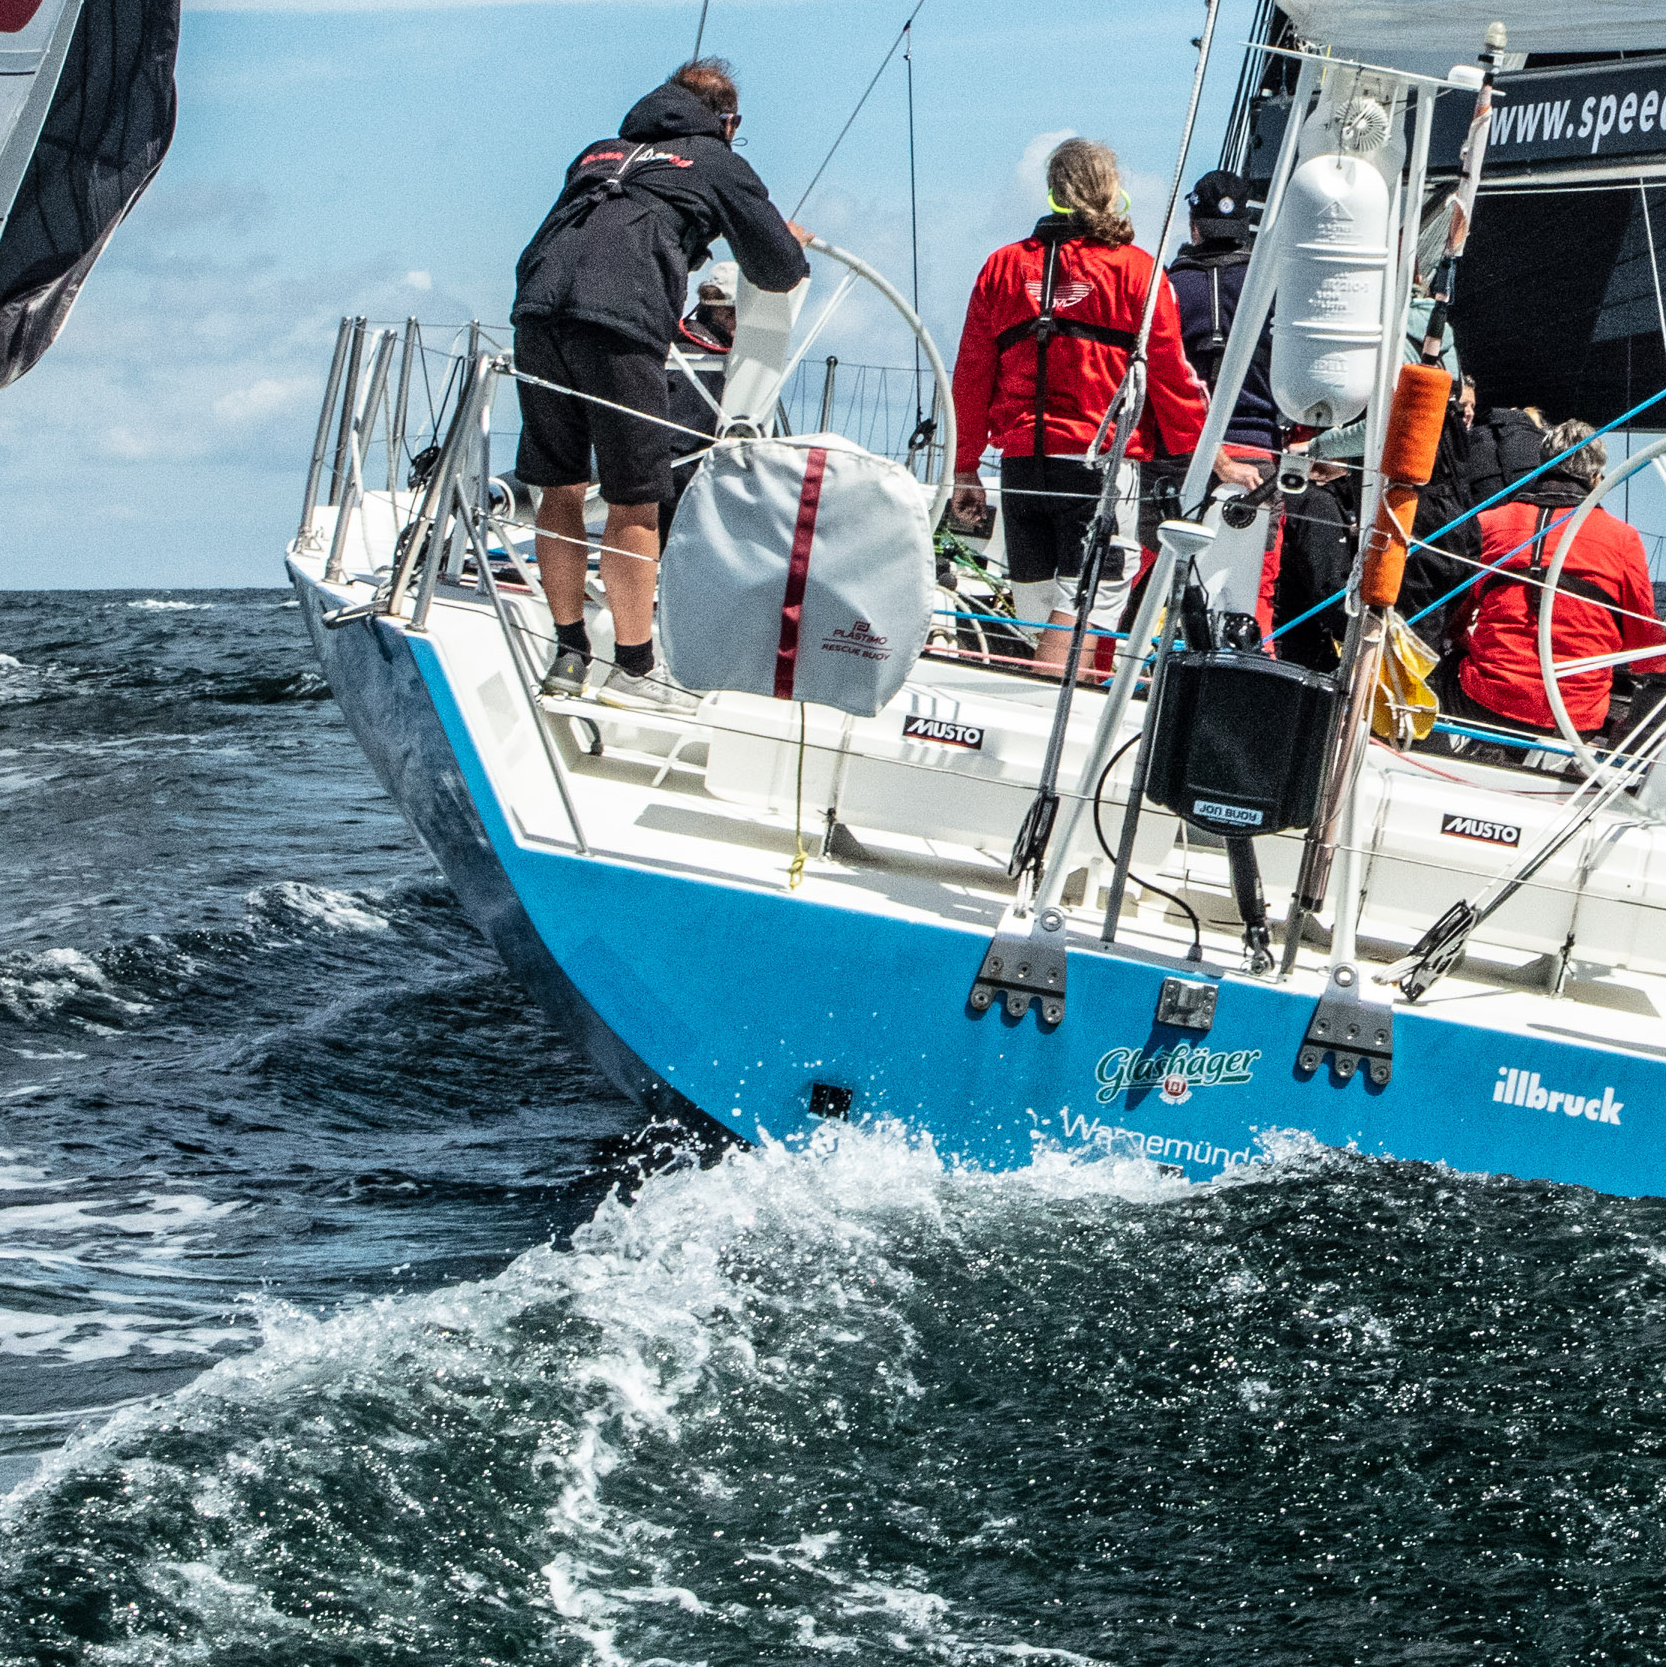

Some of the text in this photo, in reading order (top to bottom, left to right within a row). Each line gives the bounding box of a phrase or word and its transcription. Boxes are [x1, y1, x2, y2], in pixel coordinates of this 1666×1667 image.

[833, 629, 888, 645] PLASTIMO
[821, 643, 891, 661] RESCUE BUOY
[906, 718, 981, 744] MUSTO
[1224, 808, 1257, 822] BUOY
[1444, 817, 1518, 843] MUSTO
[1095, 1042, 1262, 1104] Glashäger
[1492, 1066, 1625, 1126] illbruck
